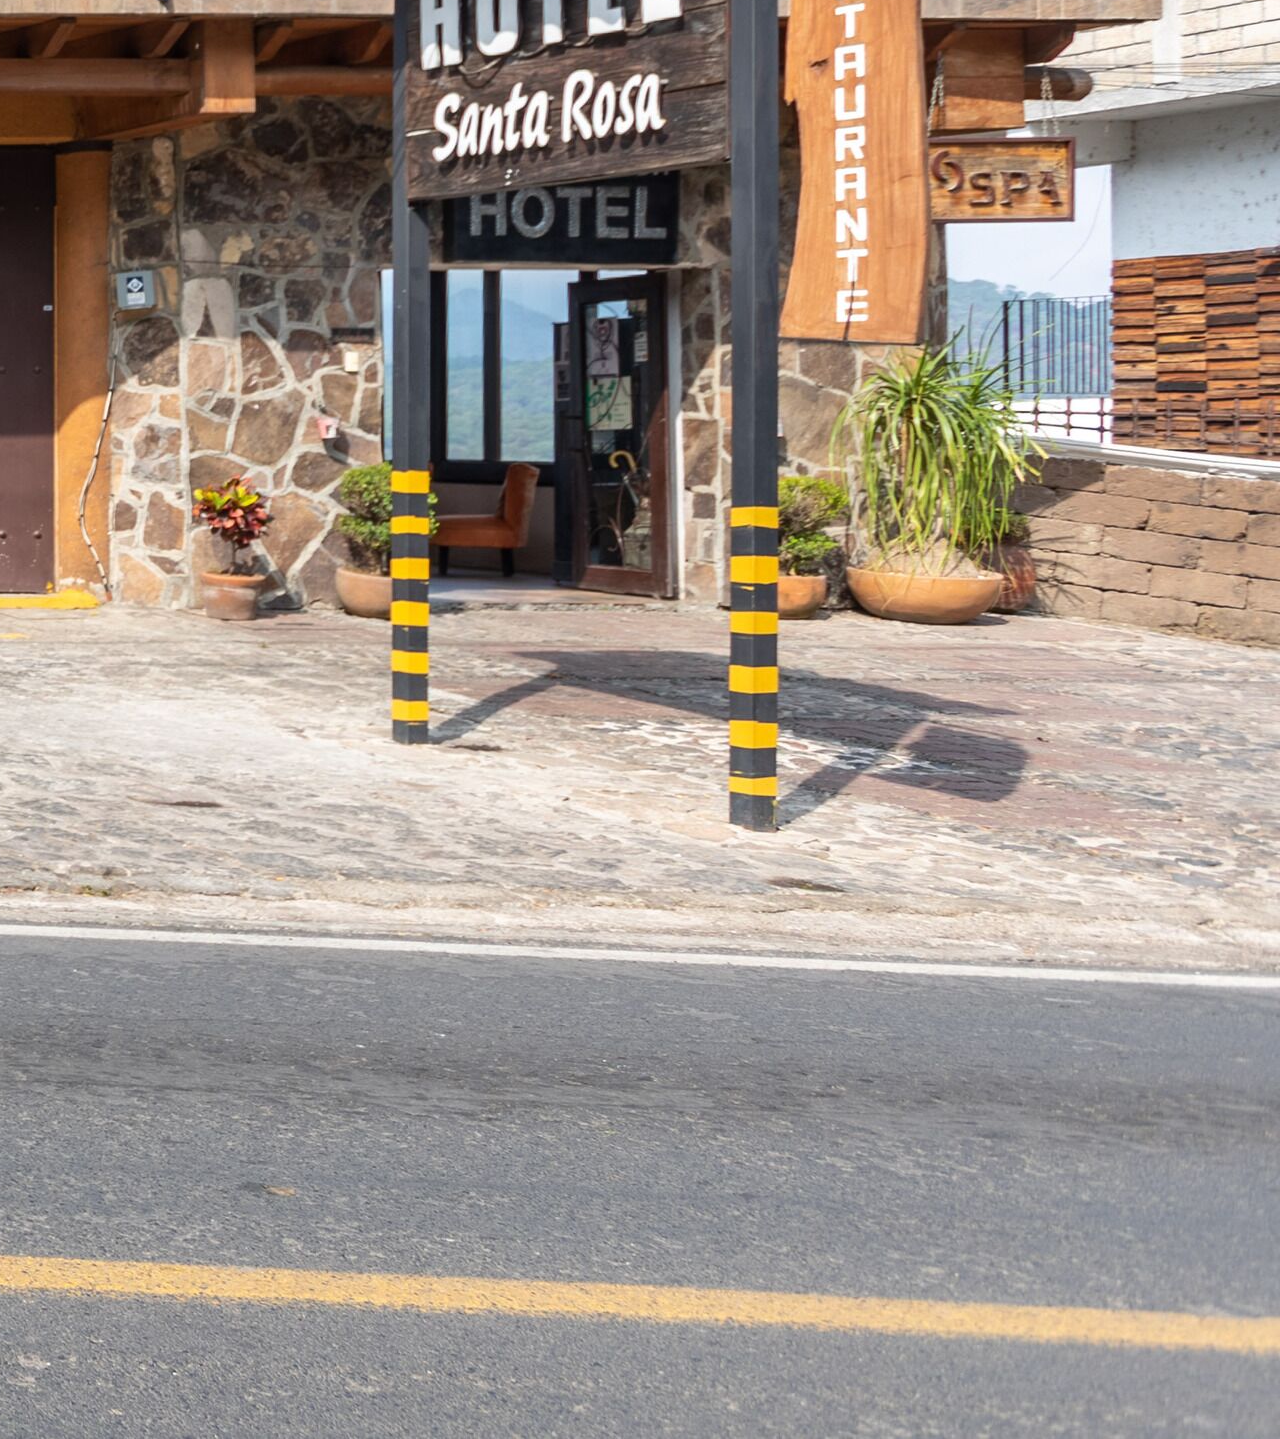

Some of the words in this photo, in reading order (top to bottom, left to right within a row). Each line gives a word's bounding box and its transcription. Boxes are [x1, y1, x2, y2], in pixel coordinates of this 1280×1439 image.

[431, 81, 552, 162] Santa
[560, 68, 668, 144] Rosa
[469, 184, 669, 241] HOTEL
[968, 170, 1064, 208] SPA
